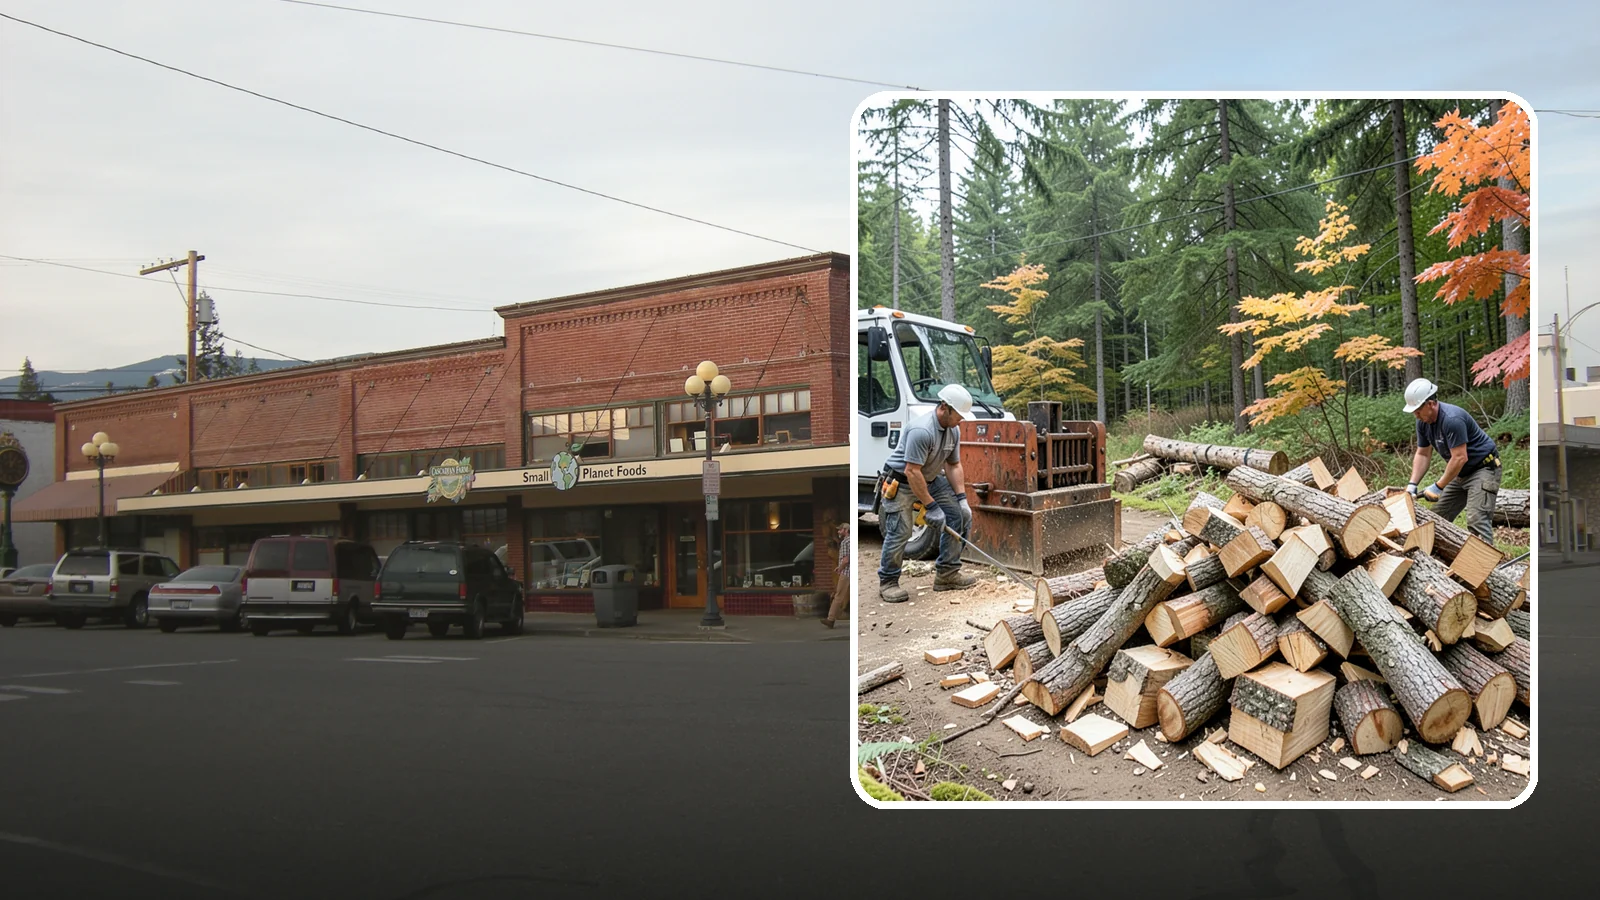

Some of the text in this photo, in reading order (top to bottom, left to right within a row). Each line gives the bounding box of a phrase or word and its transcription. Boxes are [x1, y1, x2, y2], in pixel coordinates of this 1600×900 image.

[523, 464, 647, 483] Small Planet Foods
